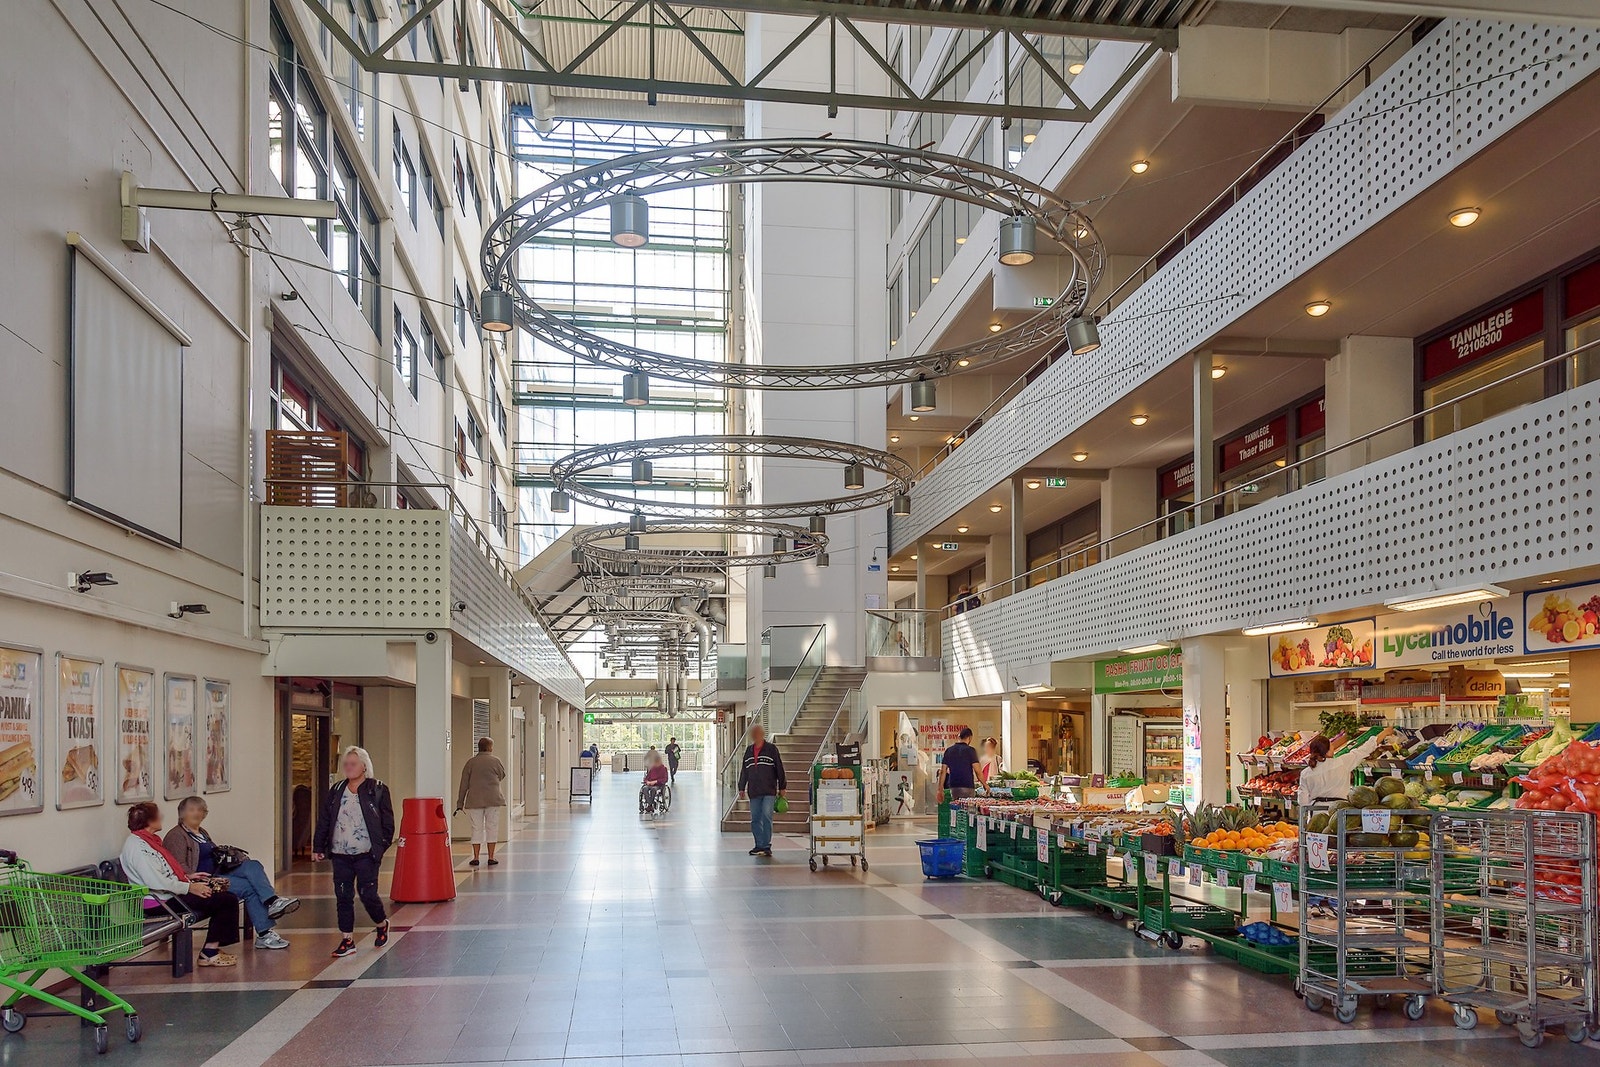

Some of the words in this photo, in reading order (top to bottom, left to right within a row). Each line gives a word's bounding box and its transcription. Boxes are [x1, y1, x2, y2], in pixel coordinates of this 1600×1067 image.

[1449, 308, 1513, 350] TANNLEGE
[1458, 329, 1503, 359] 22108300
[1244, 424, 1270, 444] TANNLEGE
[1239, 445, 1257, 461] Thaer
[1258, 436, 1274, 452] Bilal
[1173, 462, 1194, 481] TANNLE
[1383, 611, 1514, 657] Lycamobile
[1431, 650, 1446, 660] Call
[1447, 649, 1460, 659] the
[1460, 646, 1483, 657] world
[1484, 645, 1496, 655] for
[1497, 644, 1514, 654] less
[1105, 661, 1128, 677] PASHA
[1129, 657, 1154, 674] FRUKT
[1156, 655, 1169, 670] OG
[1469, 681, 1502, 692] dalan
[67, 716, 95, 739] TOAST
